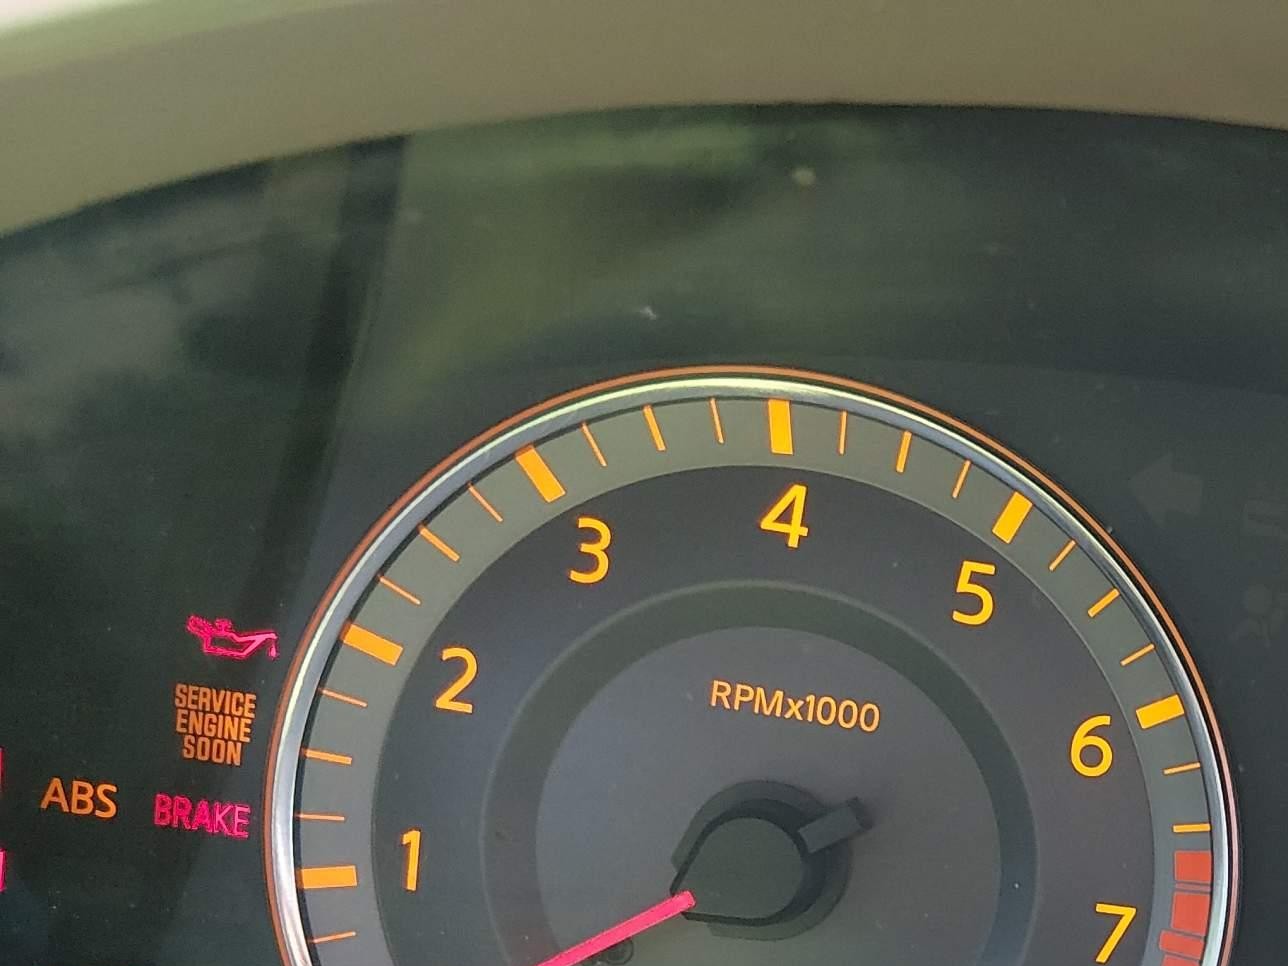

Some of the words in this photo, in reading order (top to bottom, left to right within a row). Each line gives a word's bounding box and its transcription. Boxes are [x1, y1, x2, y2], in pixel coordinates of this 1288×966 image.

[760, 484, 808, 548] 4
[569, 518, 612, 584] 3
[952, 560, 996, 626] 5
[174, 683, 257, 719] SERVICE
[435, 648, 479, 714] 2
[710, 680, 880, 733] RPMx1000
[175, 708, 252, 743] ENGINE
[182, 736, 242, 767] SOON
[1069, 715, 1113, 777] 6
[40, 777, 118, 818] ABS
[153, 793, 250, 838] BRAKE
[401, 828, 422, 891] 1
[1094, 903, 1137, 964] 7
